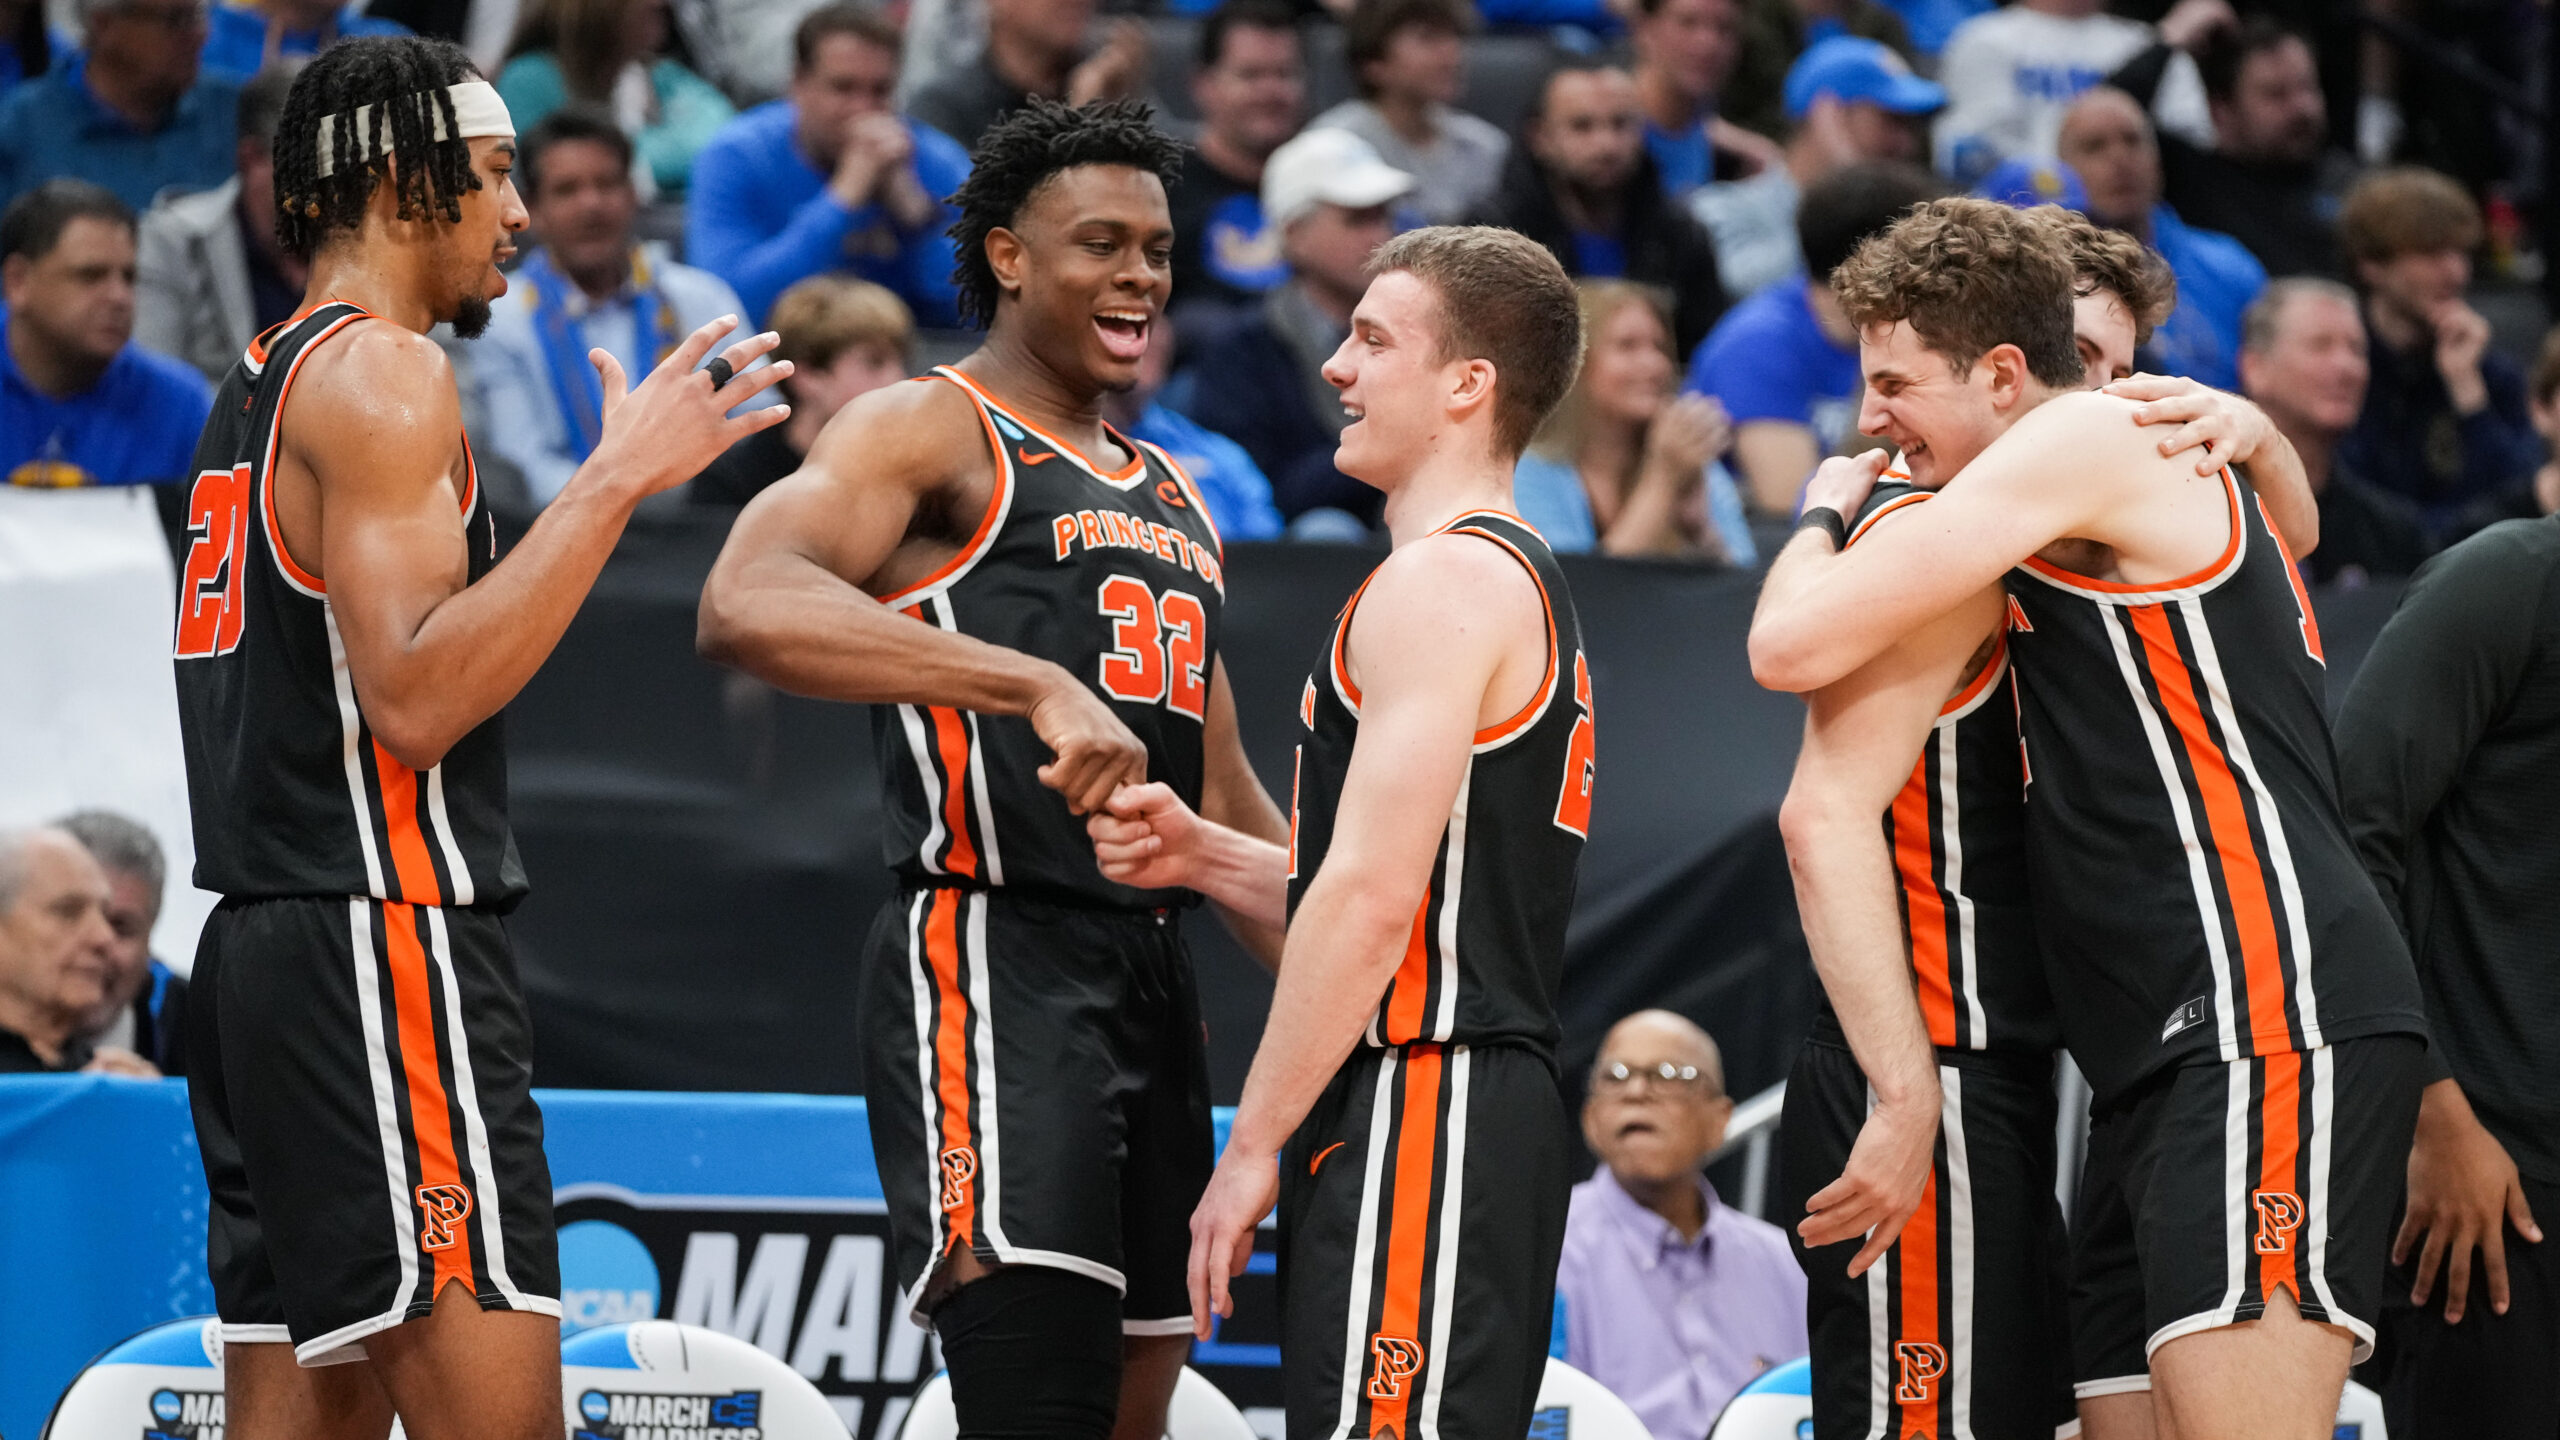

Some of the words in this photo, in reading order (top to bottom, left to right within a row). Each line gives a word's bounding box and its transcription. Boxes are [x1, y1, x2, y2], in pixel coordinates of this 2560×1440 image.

[1098, 574, 1206, 725] 32
[2189, 1007, 2197, 1019] L
[941, 1145, 977, 1212] P
[415, 1182, 473, 1252] P
[2253, 1189, 2305, 1255] P
[1367, 1333, 1424, 1400] P
[1895, 1341, 1948, 1404] P
[609, 1394, 711, 1428] MARCH
